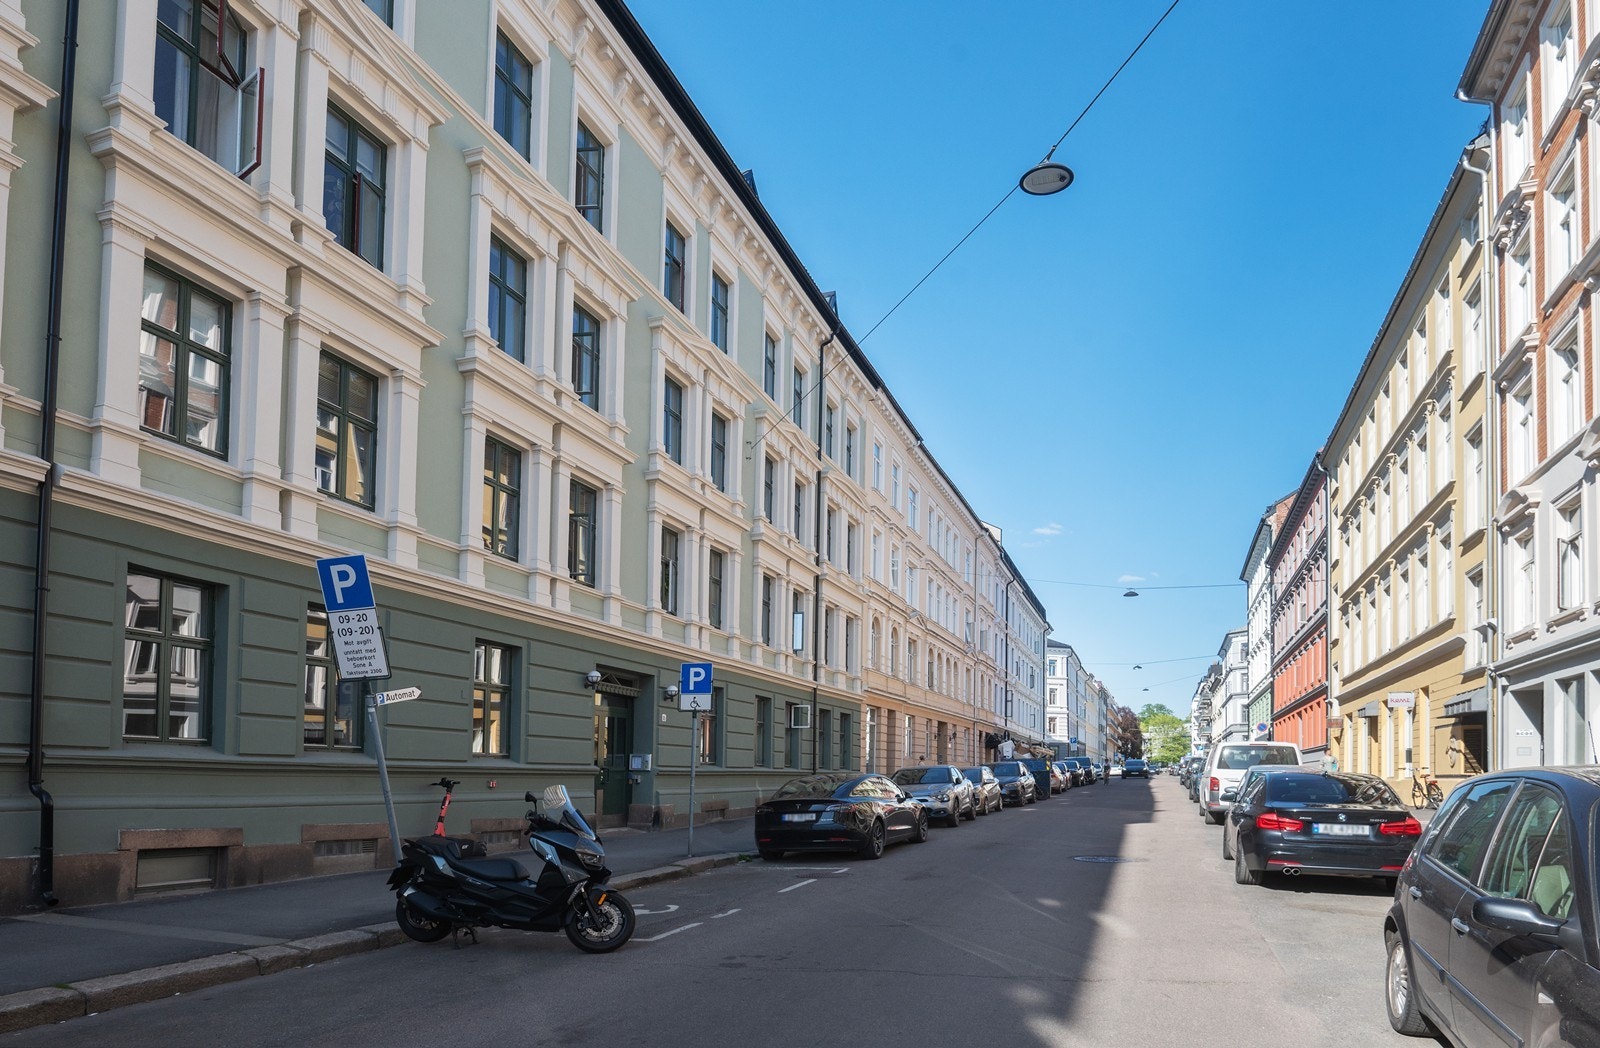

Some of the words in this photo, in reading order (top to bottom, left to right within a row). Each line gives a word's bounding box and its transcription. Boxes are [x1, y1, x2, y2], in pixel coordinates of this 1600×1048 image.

[330, 564, 357, 603] P
[338, 613, 368, 624] 09-20
[337, 625, 374, 638] (09-20)
[356, 638, 372, 647] avgift
[346, 654, 376, 662] beboerkort
[689, 667, 706, 691] P
[385, 689, 416, 702] Automat
